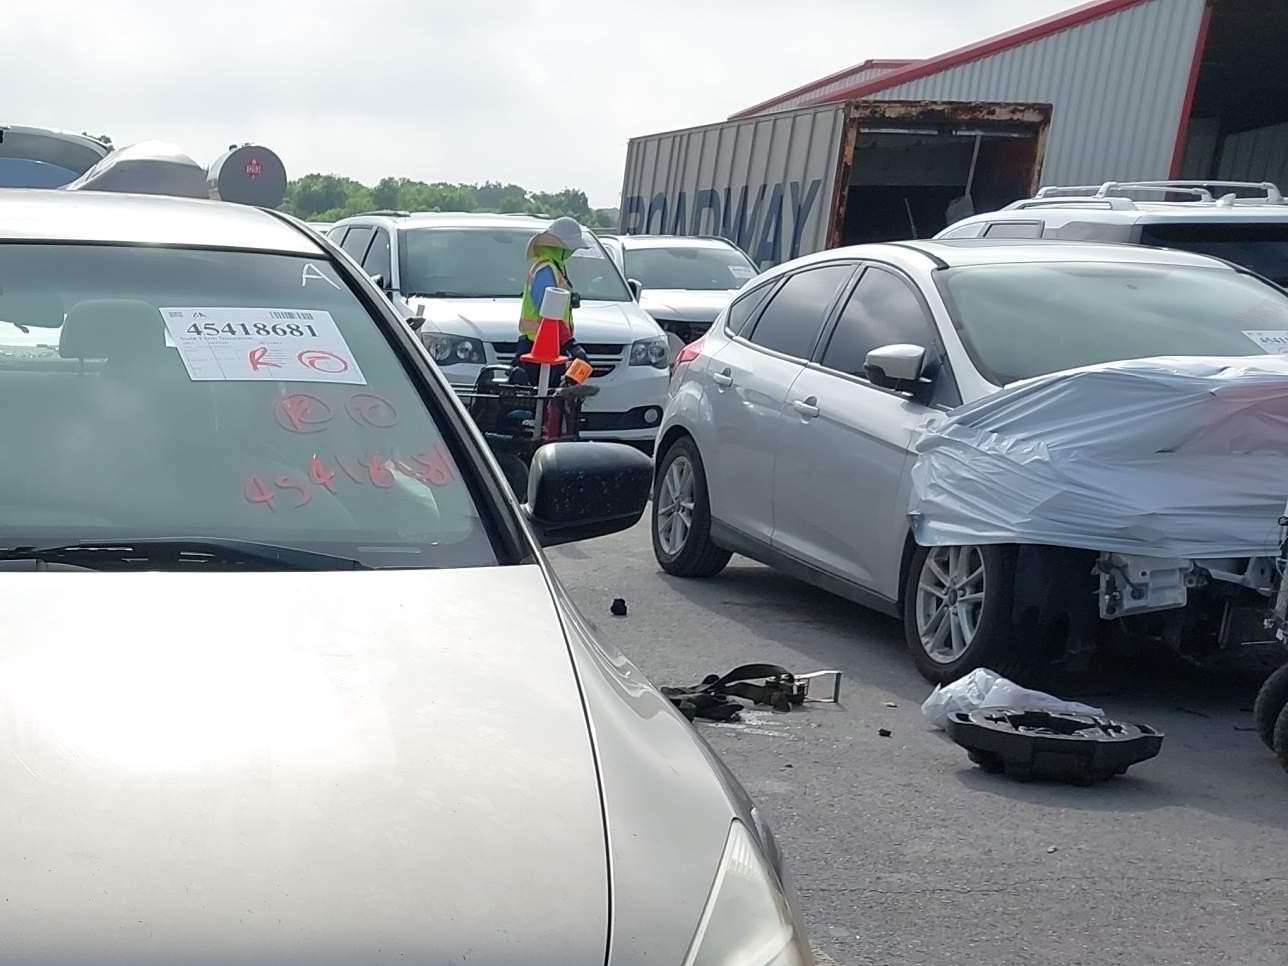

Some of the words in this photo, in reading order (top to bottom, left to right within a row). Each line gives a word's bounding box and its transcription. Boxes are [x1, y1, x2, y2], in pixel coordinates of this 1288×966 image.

[302, 263, 341, 290] A
[187, 322, 318, 337] 45418681
[249, 346, 283, 371] R
